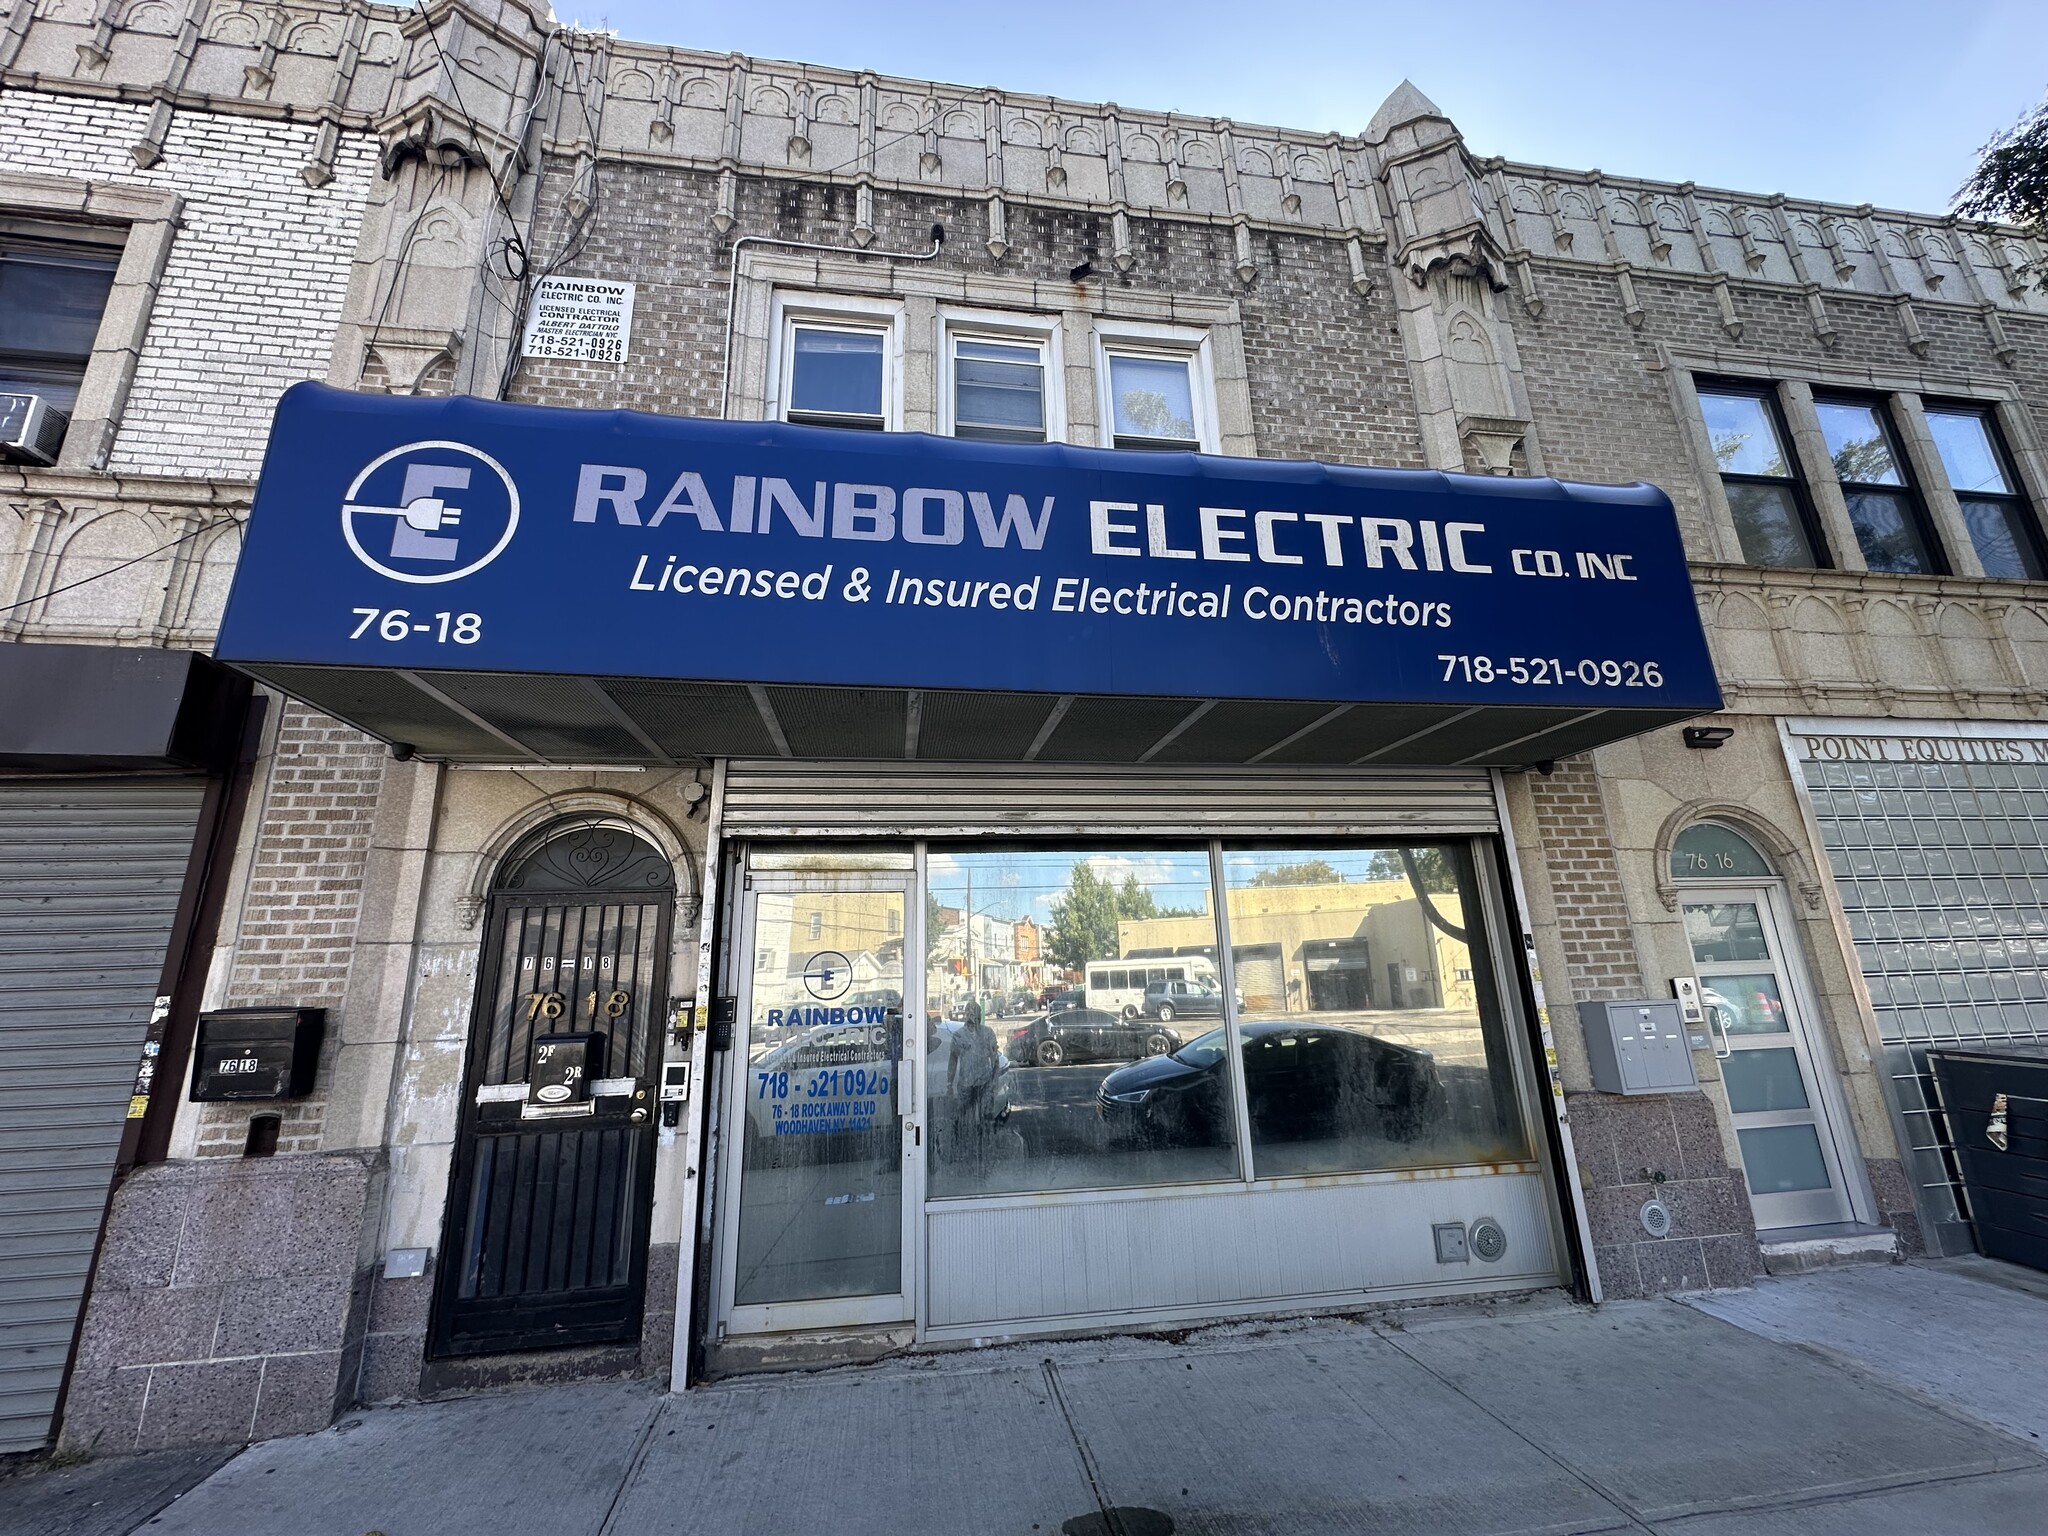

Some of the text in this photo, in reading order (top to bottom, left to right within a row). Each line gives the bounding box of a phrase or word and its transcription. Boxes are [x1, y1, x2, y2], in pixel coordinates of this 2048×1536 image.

[541, 281, 625, 295] RAINBOW
[541, 291, 624, 304] ELECTRIC CO. INC.
[539, 304, 622, 316] LICENSED ELECTRICAL
[539, 311, 620, 322] CONTRACTOR
[537, 327, 564, 335] MASTER
[565, 329, 605, 337] ELECTRICIAN
[538, 320, 621, 331] ALBERT DATTOLO
[530, 334, 623, 350] 718-521-0926
[390, 463, 472, 561] E
[573, 463, 1638, 581] RAINBOW ELECTRIC CO. INC
[629, 554, 1452, 628] Licensed & Insured Electrical Contractors
[350, 607, 483, 645] 76-18
[1437, 654, 1665, 688] 718-521-0926
[1802, 736, 1888, 760] POINT
[1897, 738, 2025, 762] EQUITIES
[1685, 851, 1734, 870] 76 16
[524, 990, 629, 1021] 76 18
[767, 1006, 887, 1027] RAINBOW
[764, 1026, 887, 1048] ELECTRIC
[537, 1045, 556, 1064] 2F
[798, 1051, 820, 1063] Insured
[820, 1049, 849, 1062] Electrical
[850, 1048, 885, 1061] Contractors
[563, 1066, 582, 1085] 2R
[758, 1071, 789, 1099] 718
[772, 1104, 783, 1120] 76
[790, 1103, 800, 1119] 18
[801, 1101, 852, 1118] ROCKAWAY
[853, 1100, 876, 1116] BLVD
